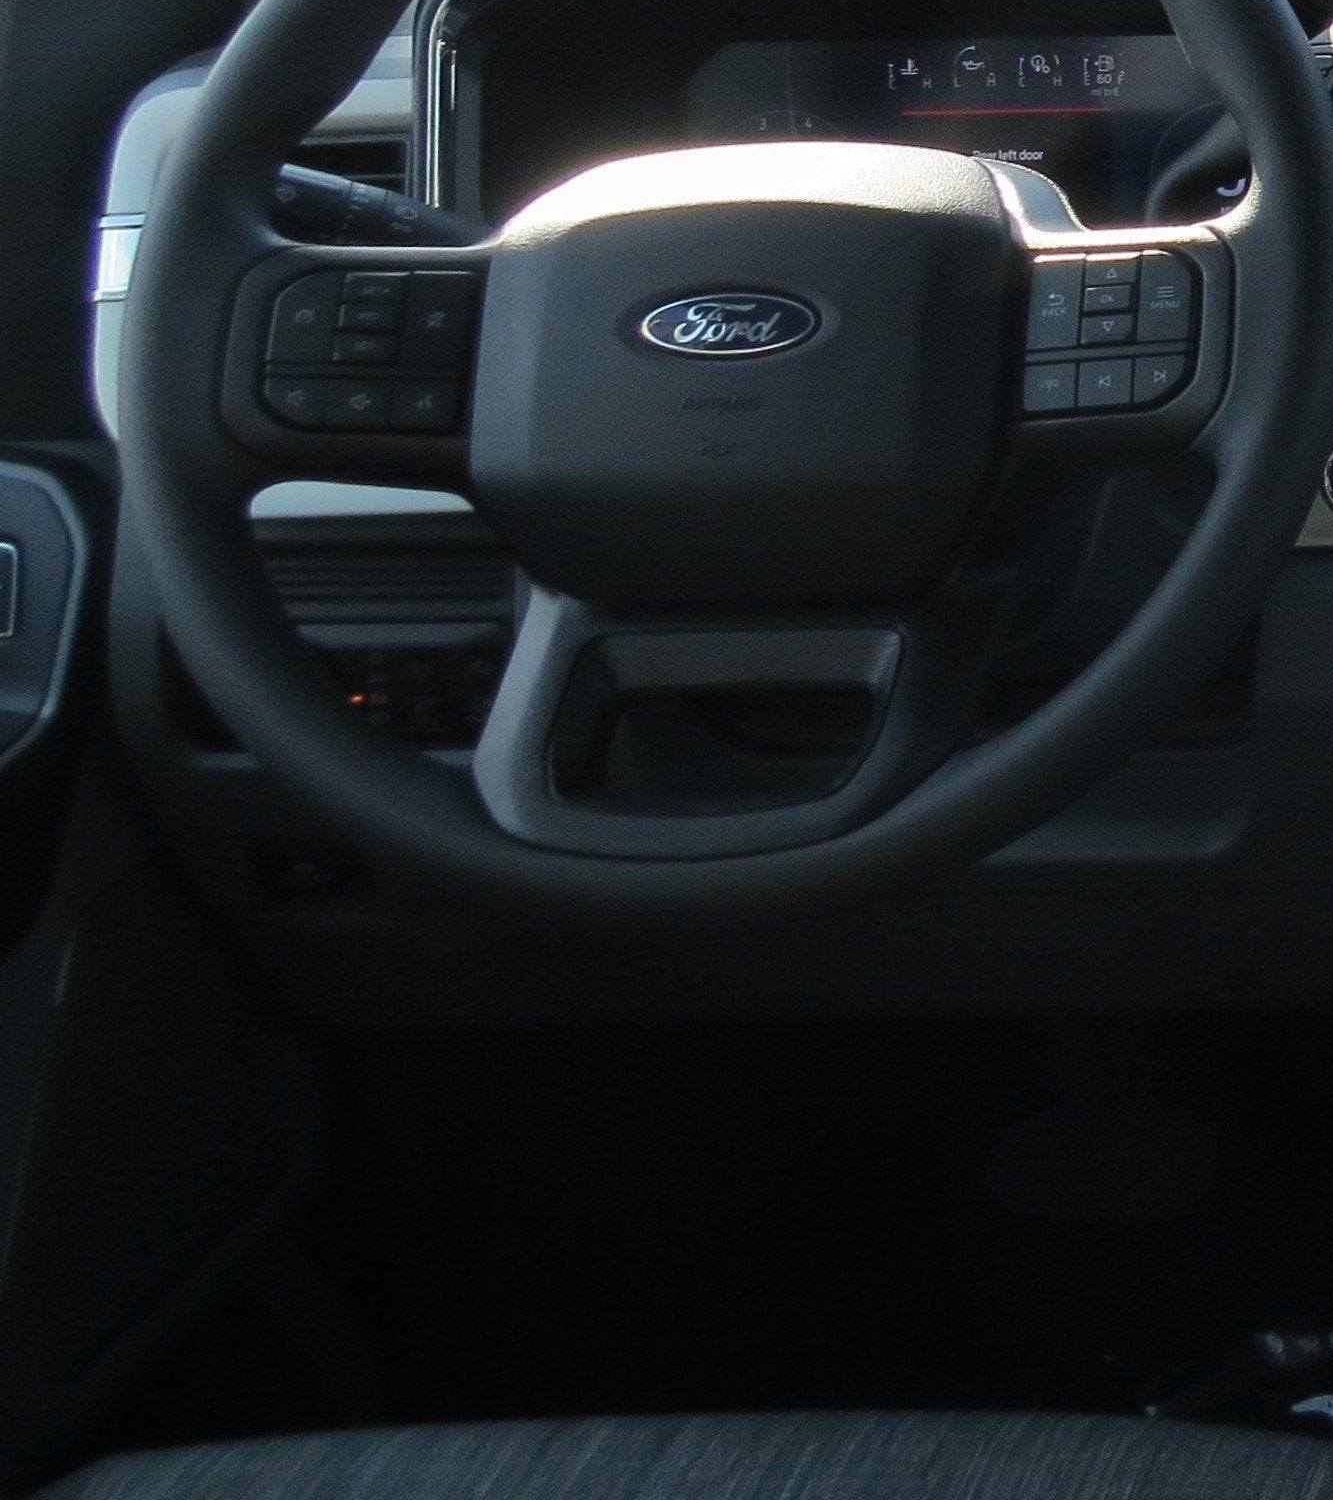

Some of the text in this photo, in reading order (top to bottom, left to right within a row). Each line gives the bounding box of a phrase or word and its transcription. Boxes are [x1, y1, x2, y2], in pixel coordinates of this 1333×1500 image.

[1020, 149, 1044, 161] door
[1151, 299, 1181, 309] MENU
[673, 302, 783, 345] Ford
